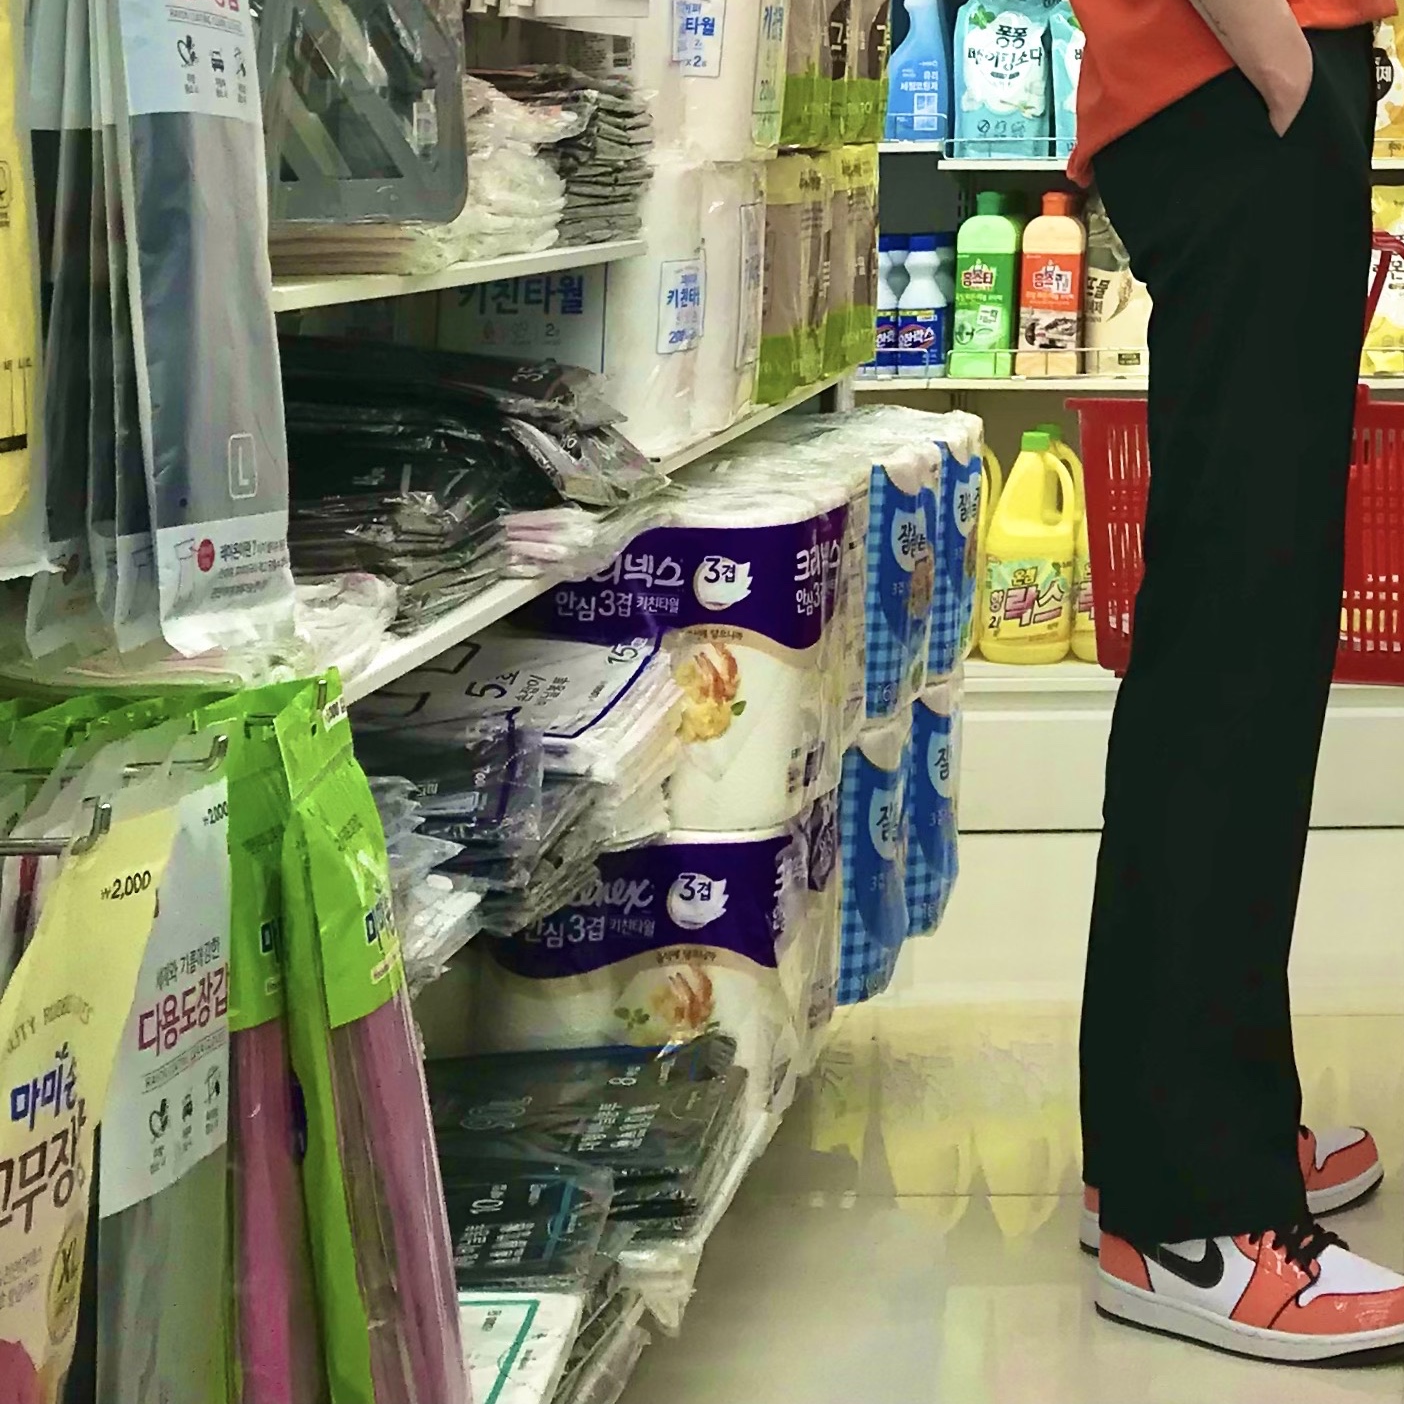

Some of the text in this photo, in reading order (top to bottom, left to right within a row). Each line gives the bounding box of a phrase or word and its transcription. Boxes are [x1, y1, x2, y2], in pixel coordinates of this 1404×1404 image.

[996, 24, 1028, 49] 퐁퐁
[968, 45, 1044, 70] 베이킹소다
[961, 271, 994, 287] 홈스타
[458, 274, 585, 316] 키친타월
[703, 556, 737, 584] 3겹
[555, 589, 681, 623] 안심 3겹 키친타월
[1004, 583, 1066, 627] 락스
[101, 869, 153, 900] ₩2,000
[679, 874, 712, 902] 3겹
[567, 914, 606, 943] 3겹
[610, 918, 656, 938] 키친타월
[138, 964, 229, 1057] 다용도장갑
